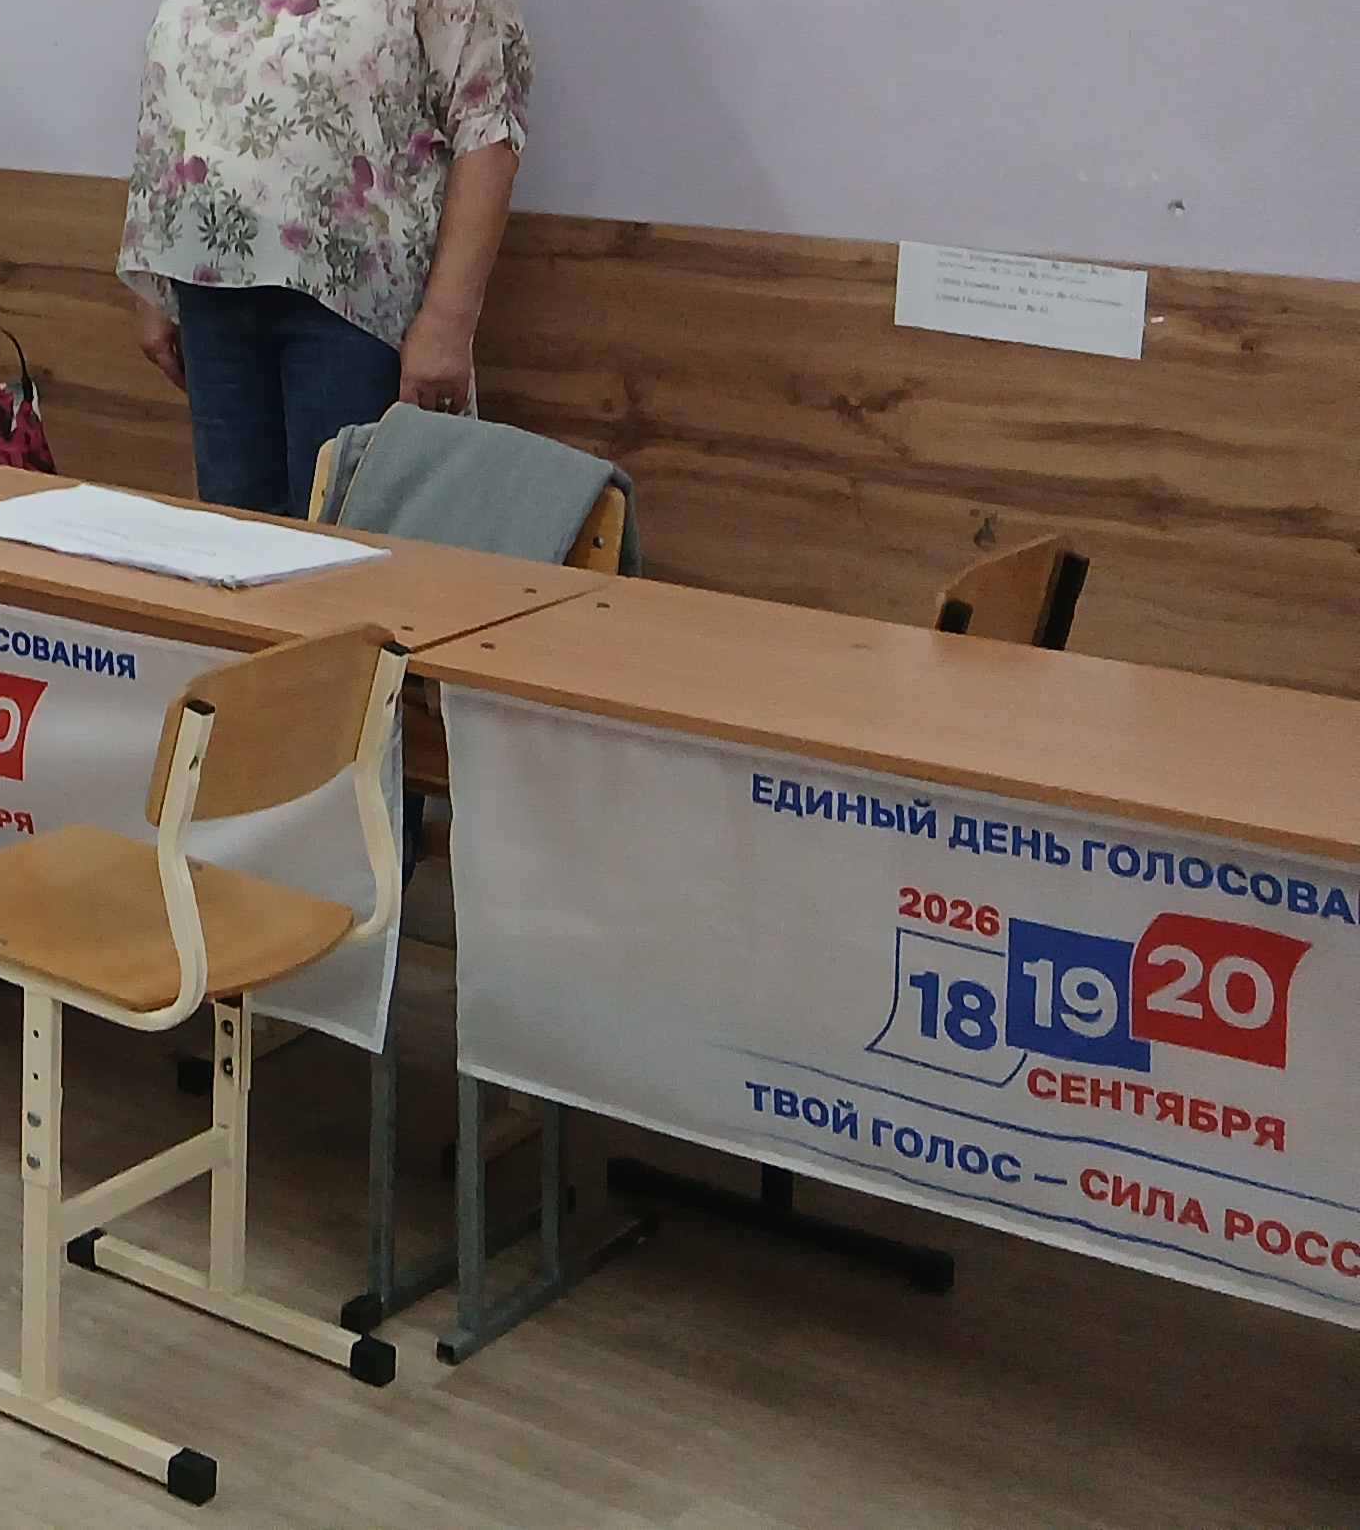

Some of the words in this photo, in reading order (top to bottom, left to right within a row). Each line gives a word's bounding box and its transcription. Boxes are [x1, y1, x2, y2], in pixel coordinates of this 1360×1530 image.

[751, 773, 937, 840] ЕДИНЫЙ
[948, 815, 1070, 866] ДЕНЬ
[1081, 839, 1360, 925] ГОЛОСОВА
[898, 887, 1000, 937] 2026
[909, 971, 998, 1051] 18
[1022, 958, 1119, 1039] 19
[1146, 944, 1275, 1030] 20
[745, 1080, 858, 1141] ТВОЙ
[871, 1117, 1022, 1185] ГОЛОС
[1080, 1168, 1210, 1234] СИЛА
[1027, 1067, 1286, 1152] СЕНТЯБРЯ
